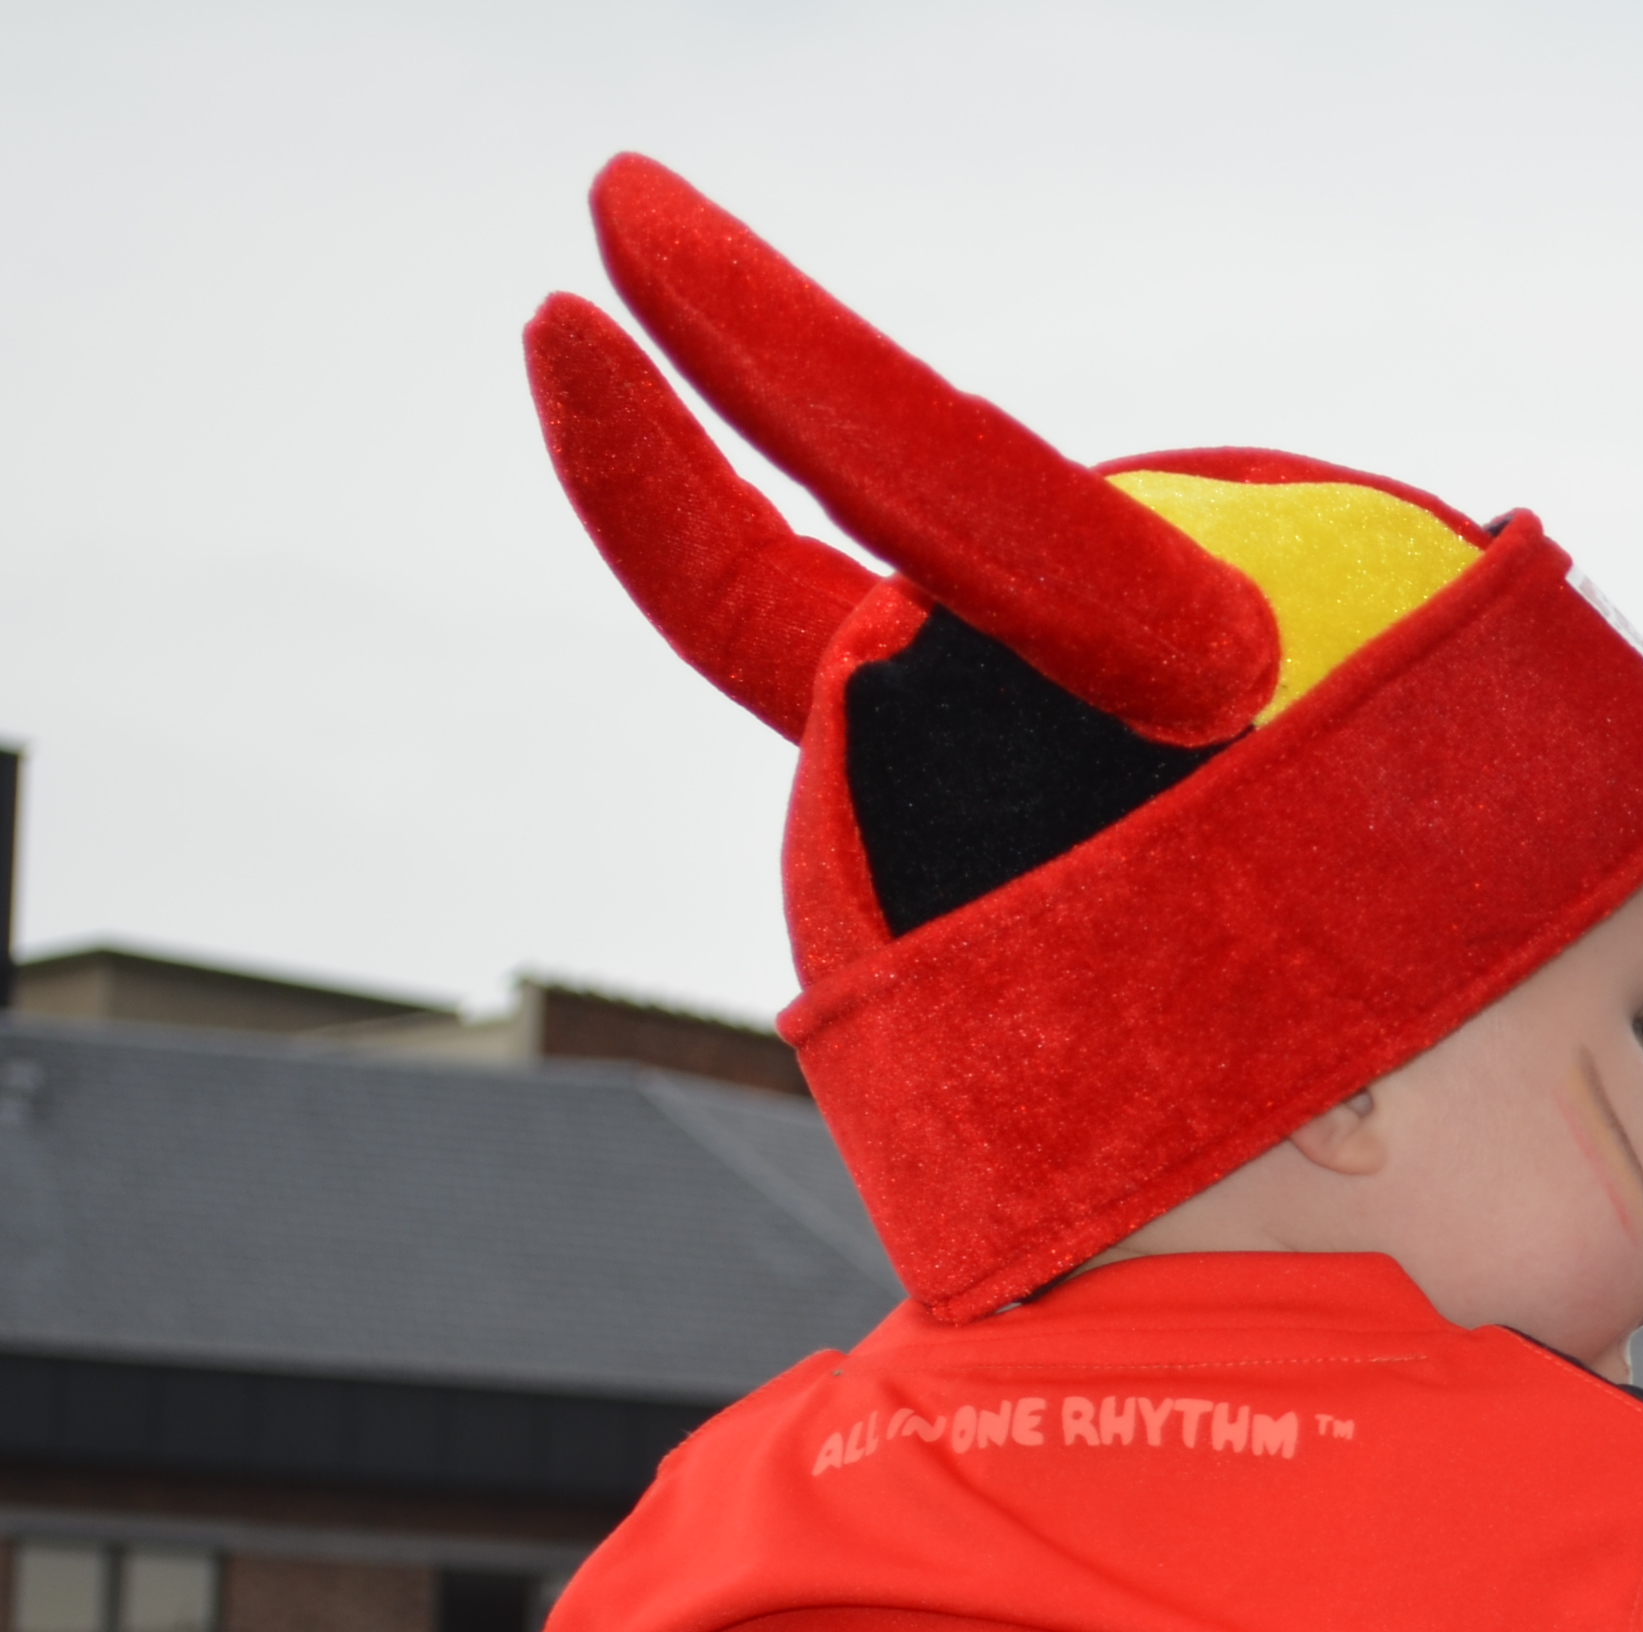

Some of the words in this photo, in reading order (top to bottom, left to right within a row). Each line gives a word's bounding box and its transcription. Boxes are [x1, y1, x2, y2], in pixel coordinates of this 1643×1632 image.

[811, 1409, 880, 1477] ALL
[951, 1396, 1047, 1455] ONE
[1061, 1396, 1298, 1459] RHYTHM
